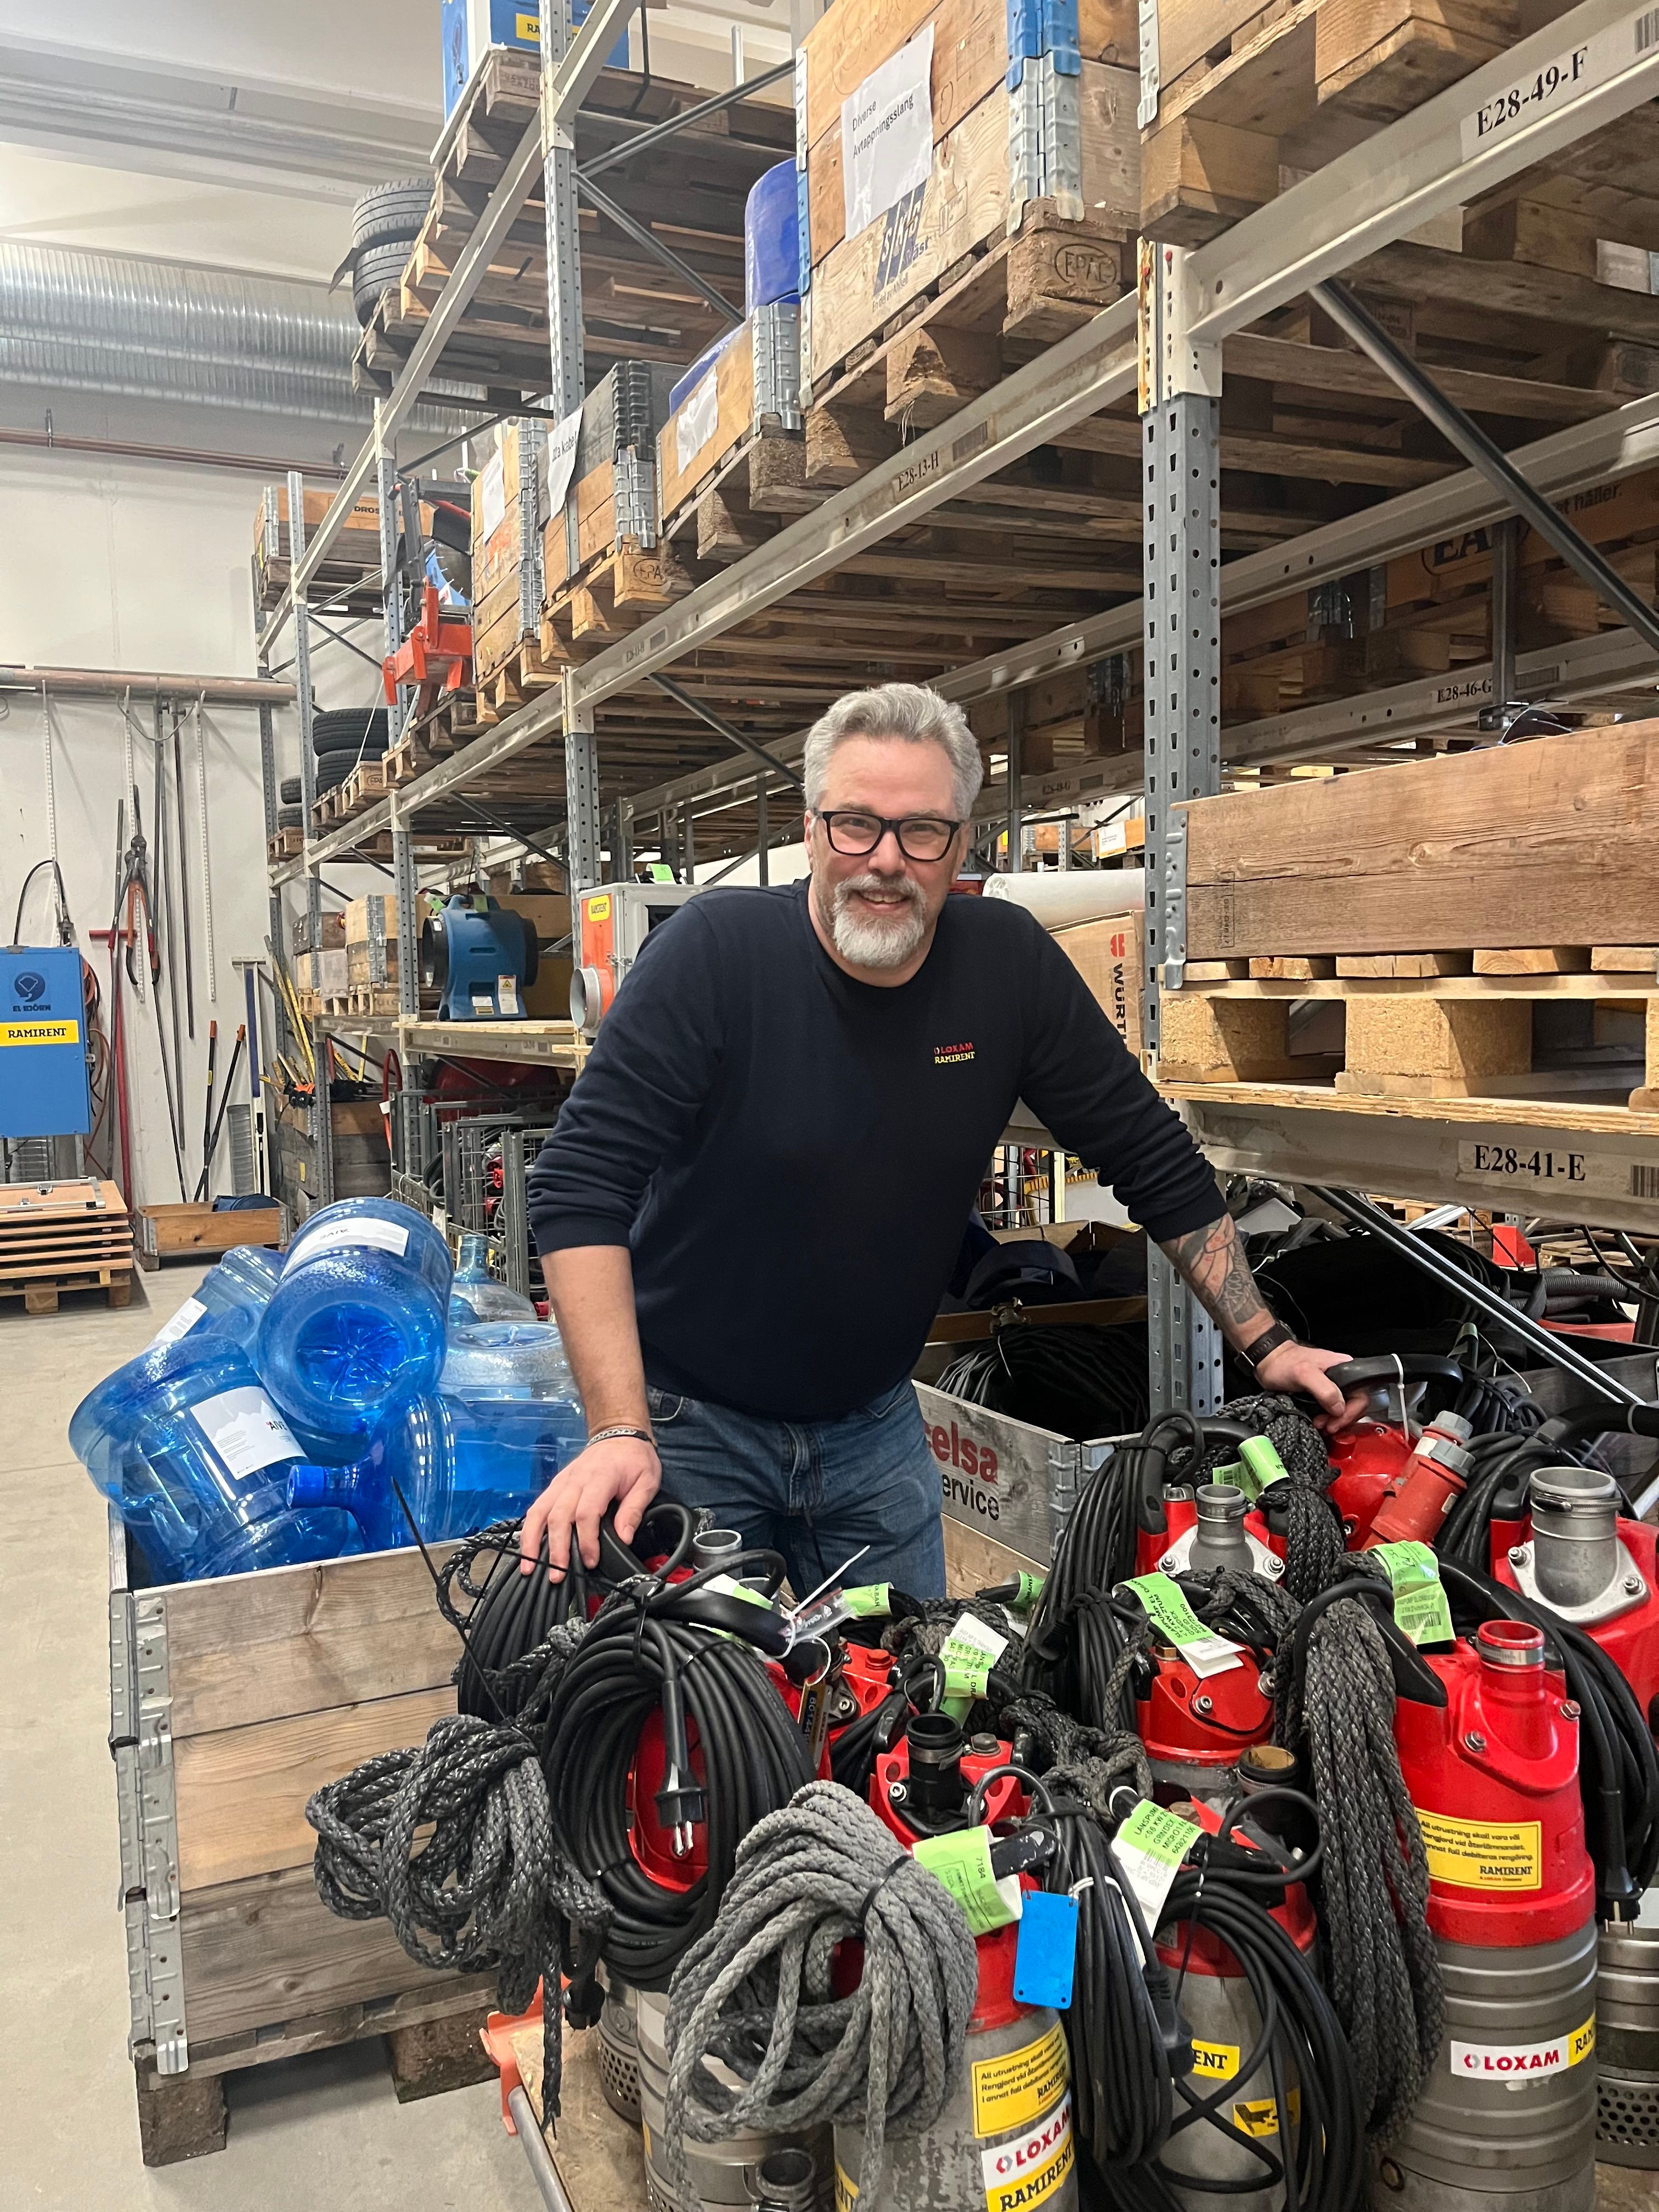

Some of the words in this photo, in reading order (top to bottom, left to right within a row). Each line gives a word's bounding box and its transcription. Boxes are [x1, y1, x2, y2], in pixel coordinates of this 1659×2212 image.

[1477, 46, 1588, 138] E28-49-F
[853, 101, 876, 132] Diverse
[853, 93, 913, 160] Avtappningsslang
[898, 450, 939, 492] E28-13-H
[1437, 678, 1492, 703] E28-46-G
[1114, 963, 1126, 1039] WÜRT
[8, 1028, 66, 1038] RAMIRENT
[935, 1051, 975, 1064] RAMIRENT
[940, 1042, 974, 1054] LOXAM
[1474, 1144, 1586, 1181] E28-41-E
[942, 1474, 999, 1521] ervice
[1421, 1820, 1431, 1829] All
[1431, 1825, 1471, 1839] utrustning
[1448, 1847, 1460, 1856] fall
[1462, 1849, 1497, 1860] debiteras
[1480, 1865, 1533, 1875] RAMIRENT
[1193, 2049, 1228, 2070] ENT
[1484, 2049, 1560, 2071] LOXAM
[1575, 2029, 1594, 2055] RAM
[981, 2072, 992, 2081] All
[993, 2059, 1030, 2078] utrustning
[981, 2075, 1015, 2092] Rengjord
[1016, 2070, 1027, 2082] vid
[986, 2090, 1009, 2103] annat
[1010, 2084, 1022, 2095] fall
[1015, 2105, 1071, 2168] LOXAM
[1000, 2142, 1072, 2212] RAMIRENT
